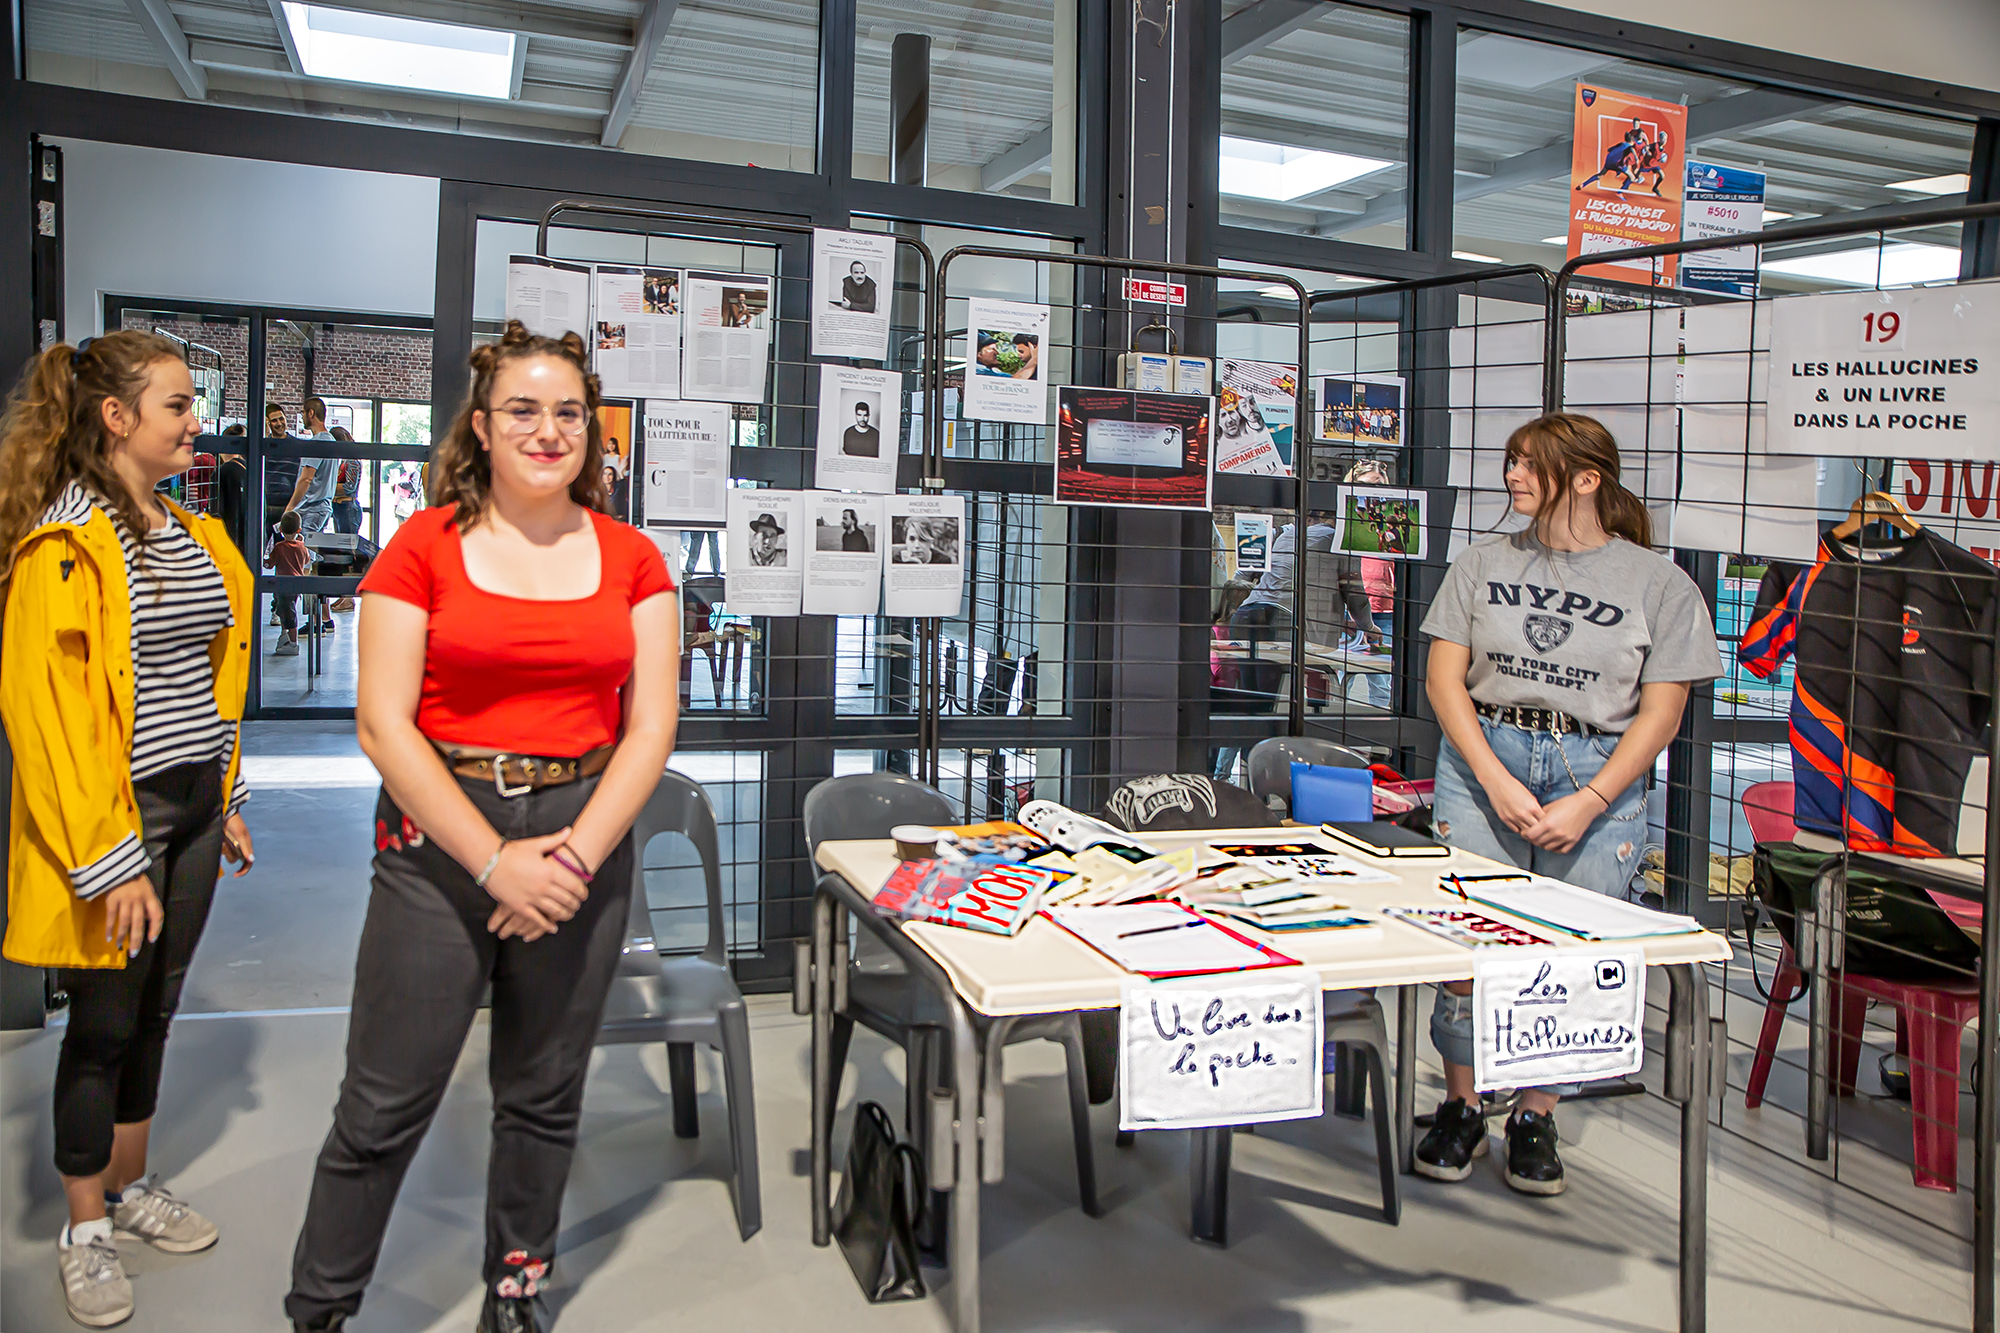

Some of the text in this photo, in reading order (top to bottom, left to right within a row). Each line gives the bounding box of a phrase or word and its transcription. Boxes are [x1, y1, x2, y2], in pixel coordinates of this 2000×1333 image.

[1700, 192, 1714, 200] VOTE
[1715, 193, 1730, 201] POUR
[1738, 194, 1759, 202] PROJET
[1585, 198, 1667, 220] LES COPAINS ET
[1707, 205, 1740, 220] #5010
[1574, 209, 1589, 221] LE
[1588, 211, 1626, 227] RUGBY
[1583, 222, 1666, 244] DU 14 AU 22 SEPTEMBRE
[1699, 222, 1726, 233] TERRAIN
[1727, 226, 1738, 234] DE
[1862, 311, 1901, 344] 19
[1791, 357, 1979, 377] LES HALLUCINES
[982, 383, 999, 391] TOUR
[1005, 386, 1030, 394] FRANCE
[1814, 386, 1947, 403] & UN LIVRE
[1223, 392, 1235, 404] 20
[648, 417, 701, 431] TOUS POUR
[1793, 413, 1968, 430] DANS LA POCHE
[647, 430, 657, 439] LA
[659, 430, 713, 442] LITTÉRATURE
[1486, 580, 1626, 628] NYPD
[1718, 605, 1732, 613] 24
[1486, 651, 1601, 682] NEW YORK CITY
[1495, 663, 1587, 693] POLICE DEPT.
